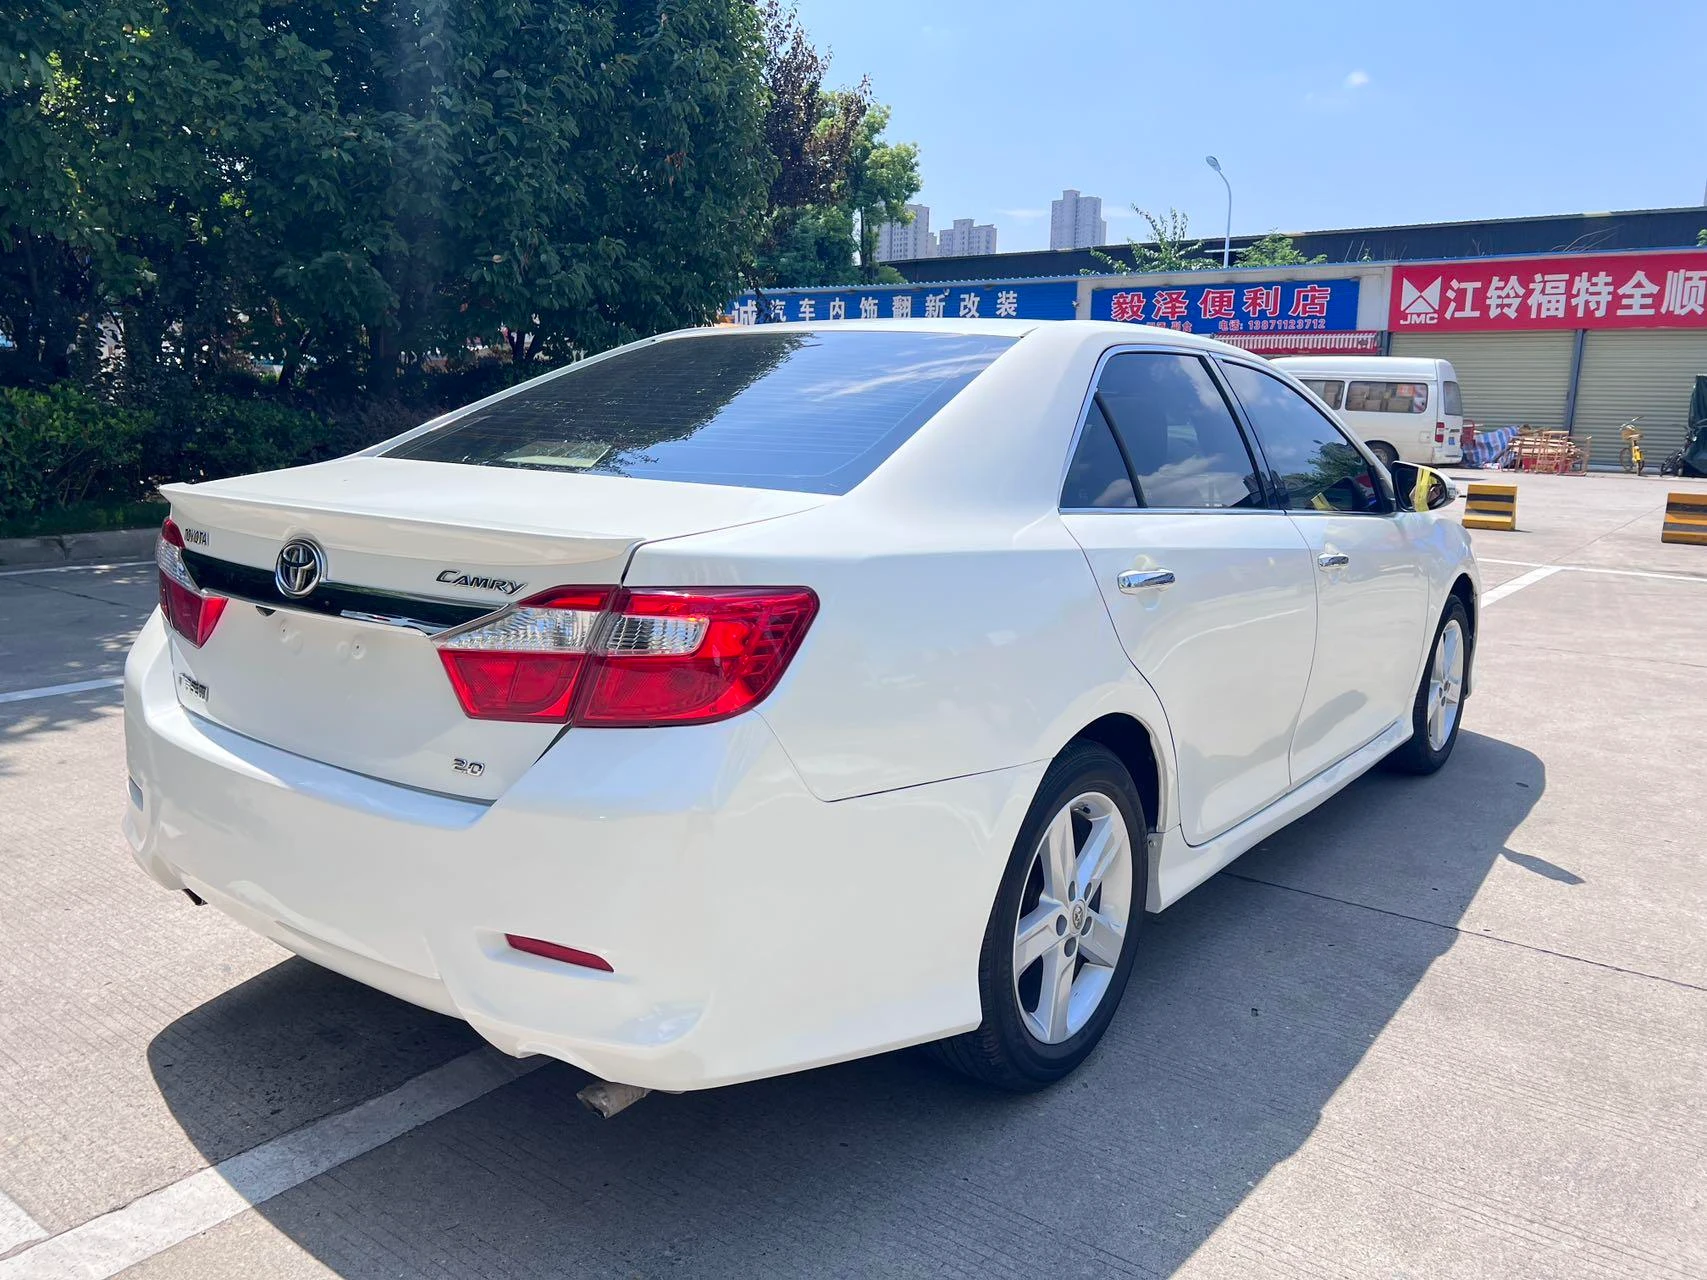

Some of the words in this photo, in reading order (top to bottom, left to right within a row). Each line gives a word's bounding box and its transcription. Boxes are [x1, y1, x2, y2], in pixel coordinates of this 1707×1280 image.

[1111, 285, 1331, 321] 毅泽便利店
[1444, 269, 1707, 319] 江铃福特全顺
[1400, 312, 1438, 324] JMC
[435, 569, 528, 596] CAMRY
[452, 758, 485, 777] 2.0
